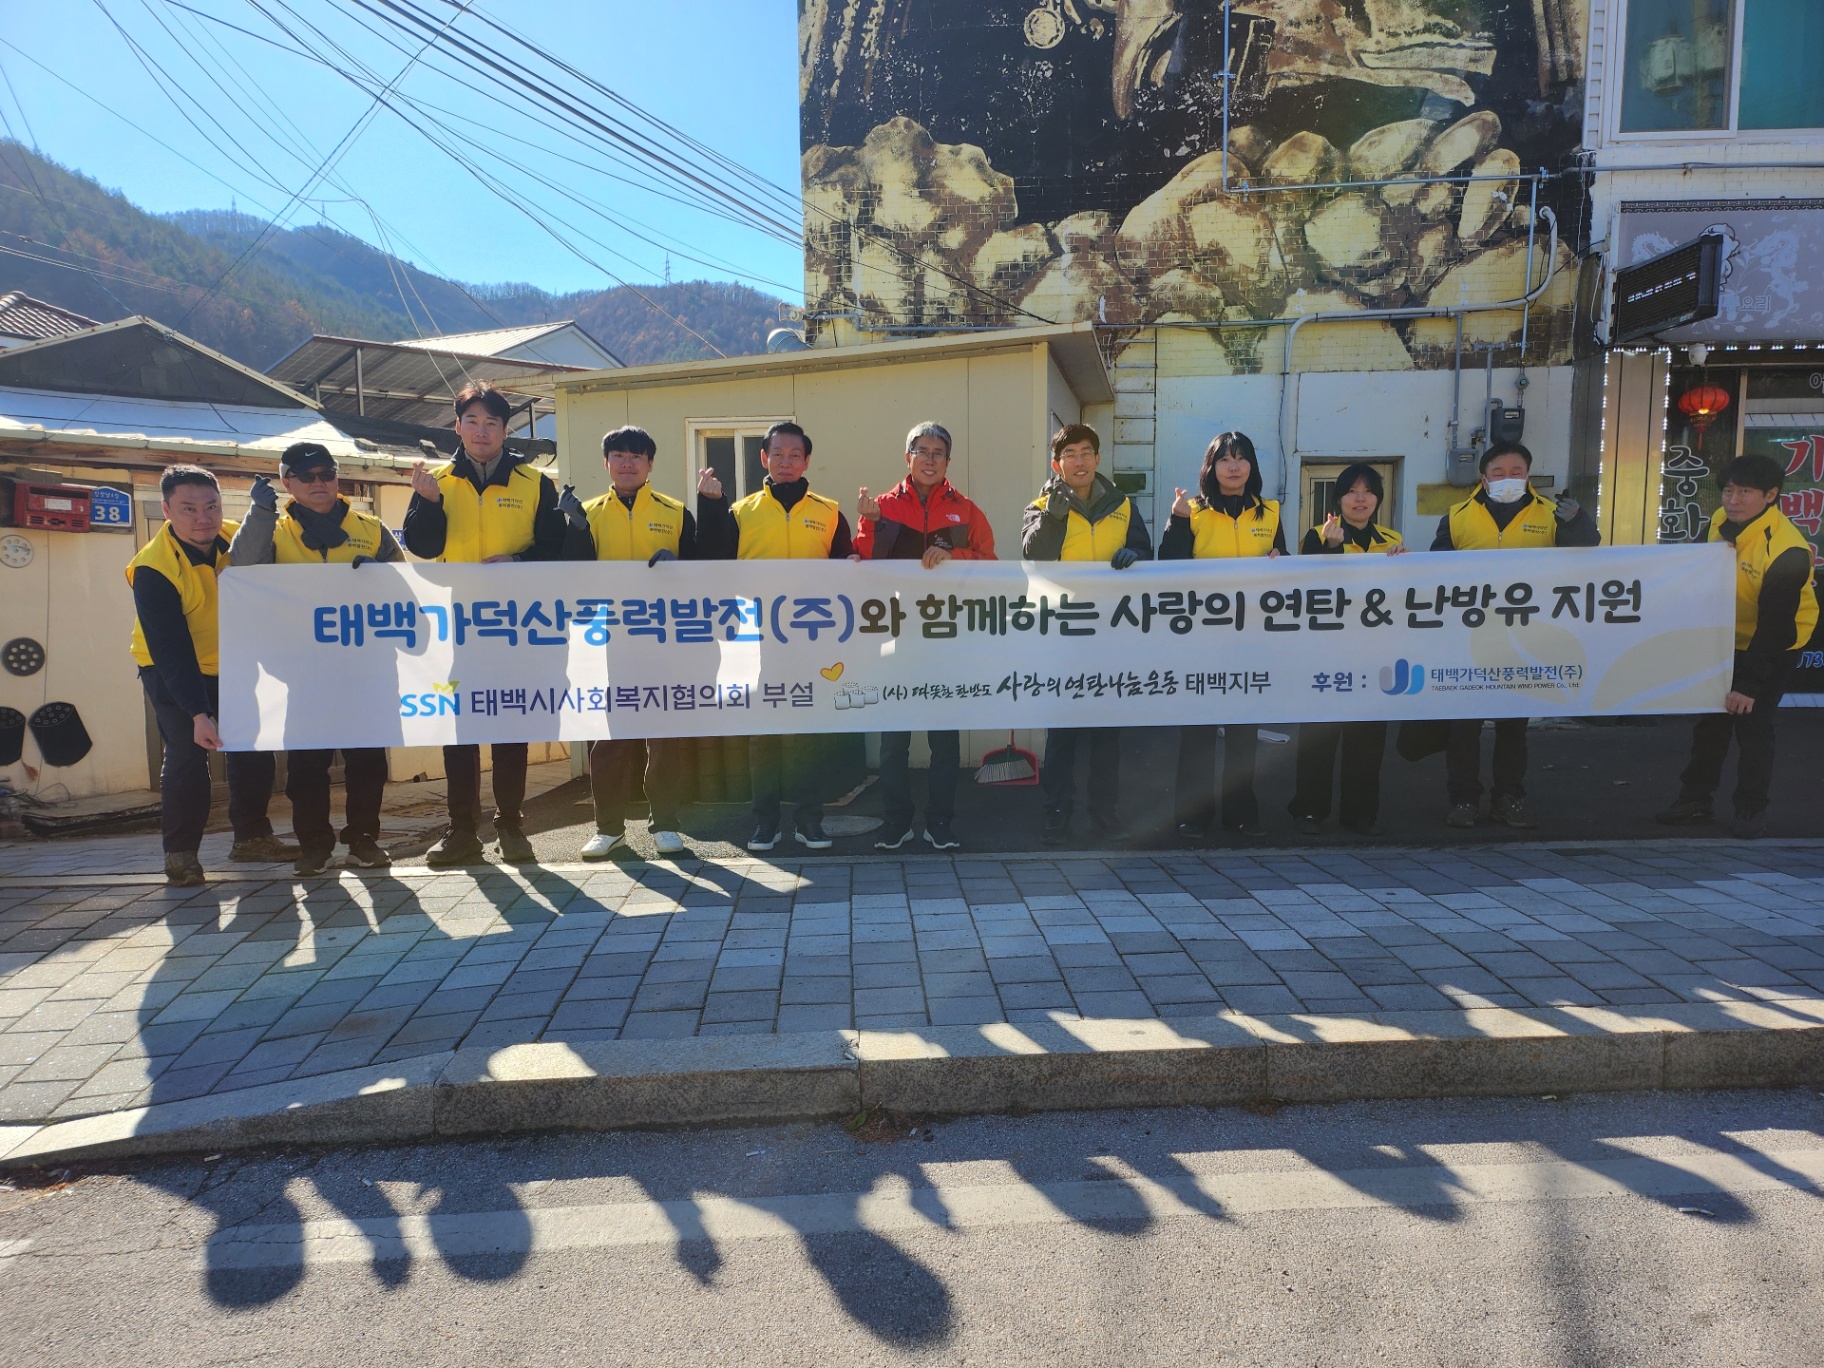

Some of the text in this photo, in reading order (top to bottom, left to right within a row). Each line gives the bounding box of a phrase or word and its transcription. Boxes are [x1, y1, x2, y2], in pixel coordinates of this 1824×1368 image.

[1739, 295, 1771, 316] 요리
[1658, 445, 1711, 541] 중화
[94, 505, 120, 522] 38
[916, 592, 1099, 639] 함께하는
[1111, 590, 1245, 635] 사랑의
[1260, 588, 1352, 631] 연탄
[1361, 589, 1393, 627] &
[1406, 583, 1540, 628] 난방유
[1552, 580, 1641, 624] 지원
[1185, 670, 1272, 696] 태백지부
[1311, 671, 1353, 693] 후원
[1431, 664, 1583, 683] 태백가덕산풍력발전(주)
[400, 694, 460, 718] SSN
[471, 682, 814, 717] 태백시사회복지협의회 부설
